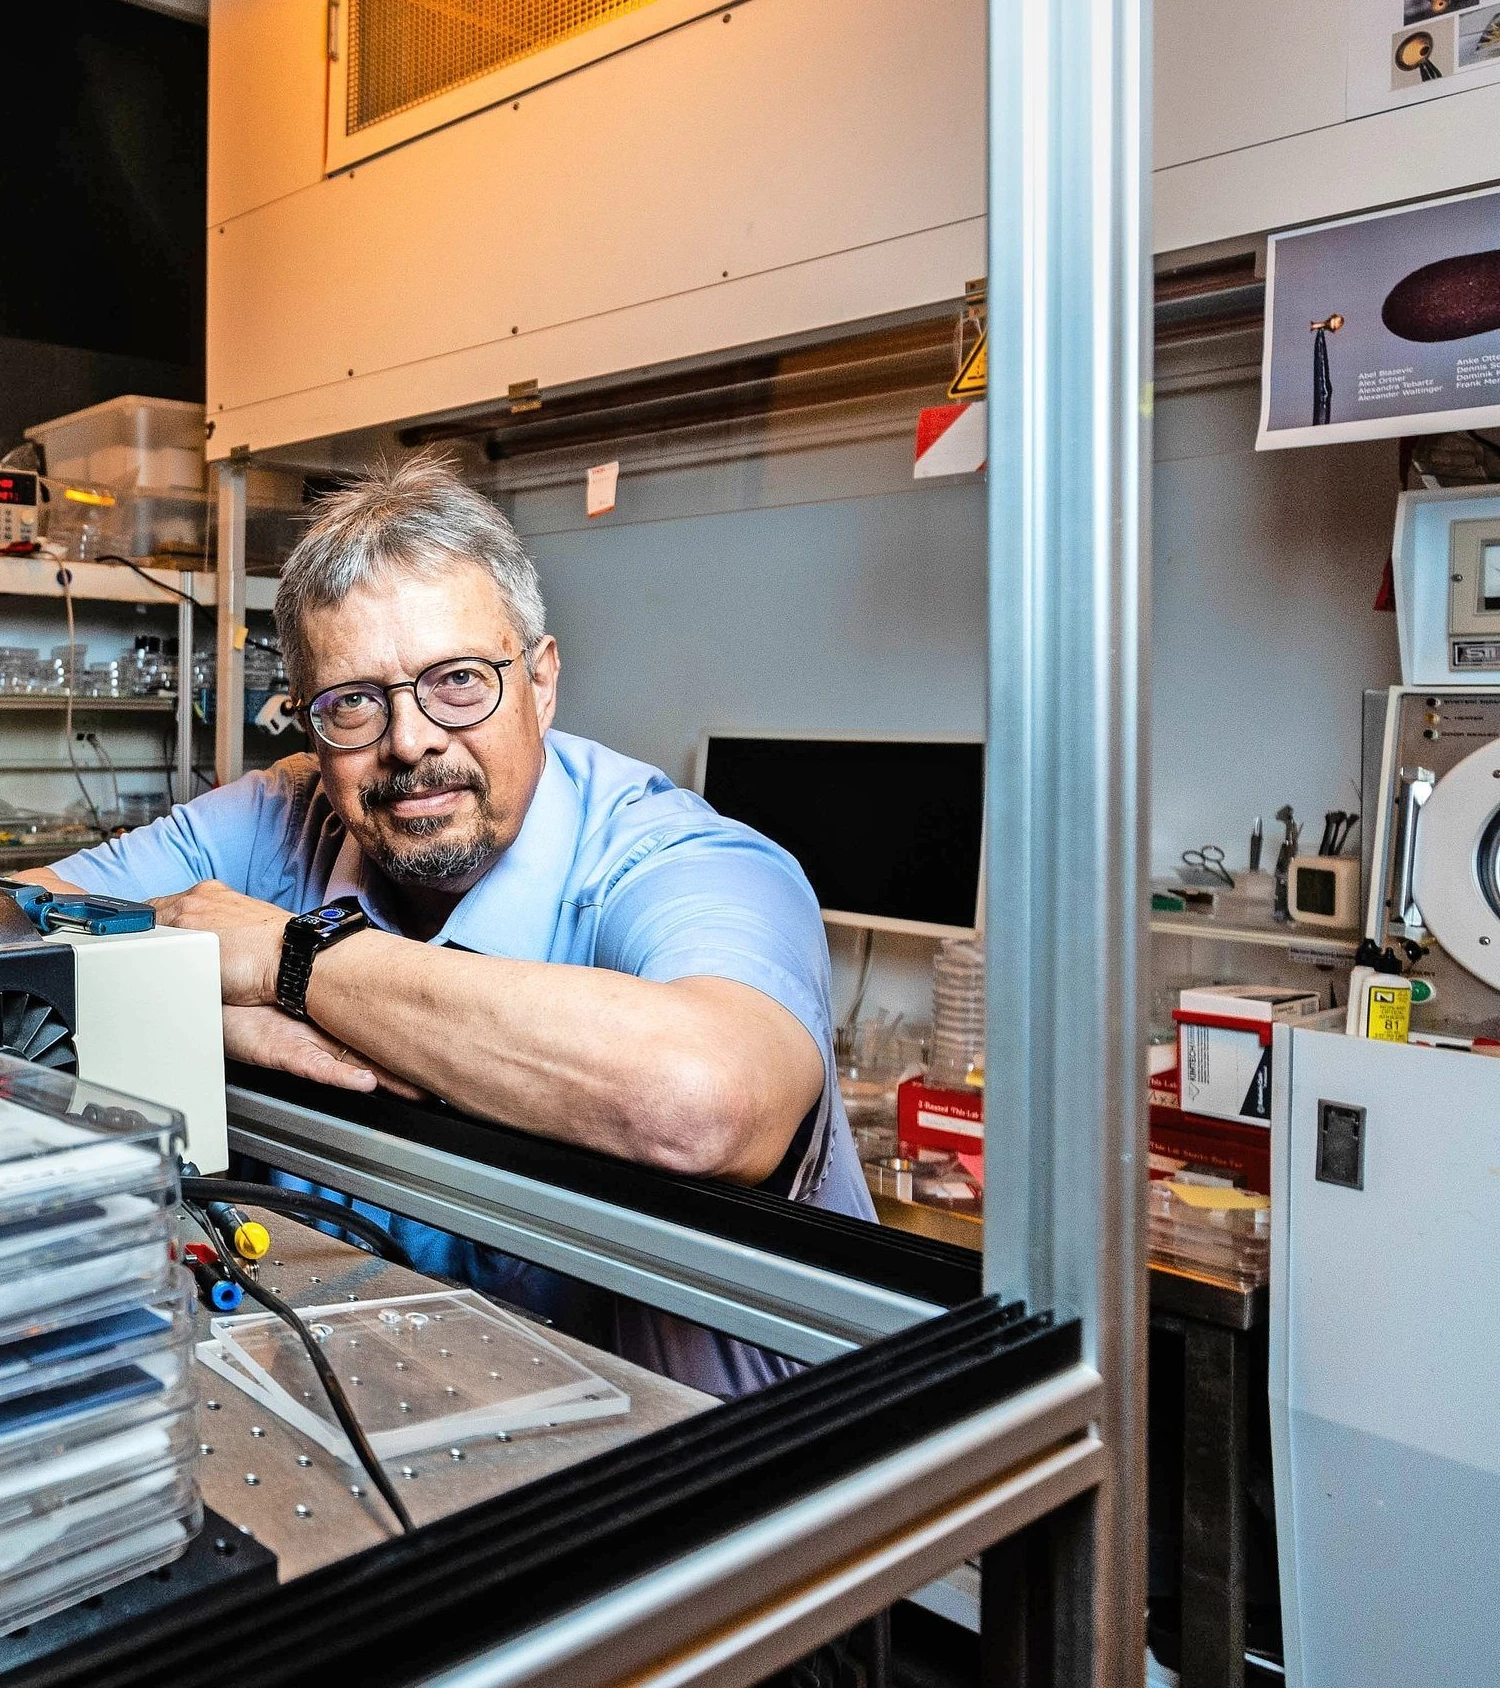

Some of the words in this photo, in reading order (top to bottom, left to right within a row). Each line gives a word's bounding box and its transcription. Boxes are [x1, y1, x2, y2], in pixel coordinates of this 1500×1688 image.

[1457, 358, 1480, 366] Anke
[1457, 364, 1488, 374] Dennis
[1457, 371, 1493, 381] Dominik
[1358, 379, 1377, 387] Alex
[1456, 379, 1482, 389] Frank
[1358, 384, 1400, 394] Alexandra
[1358, 391, 1400, 401] Alexander
[1385, 1019, 1399, 1030] 81
